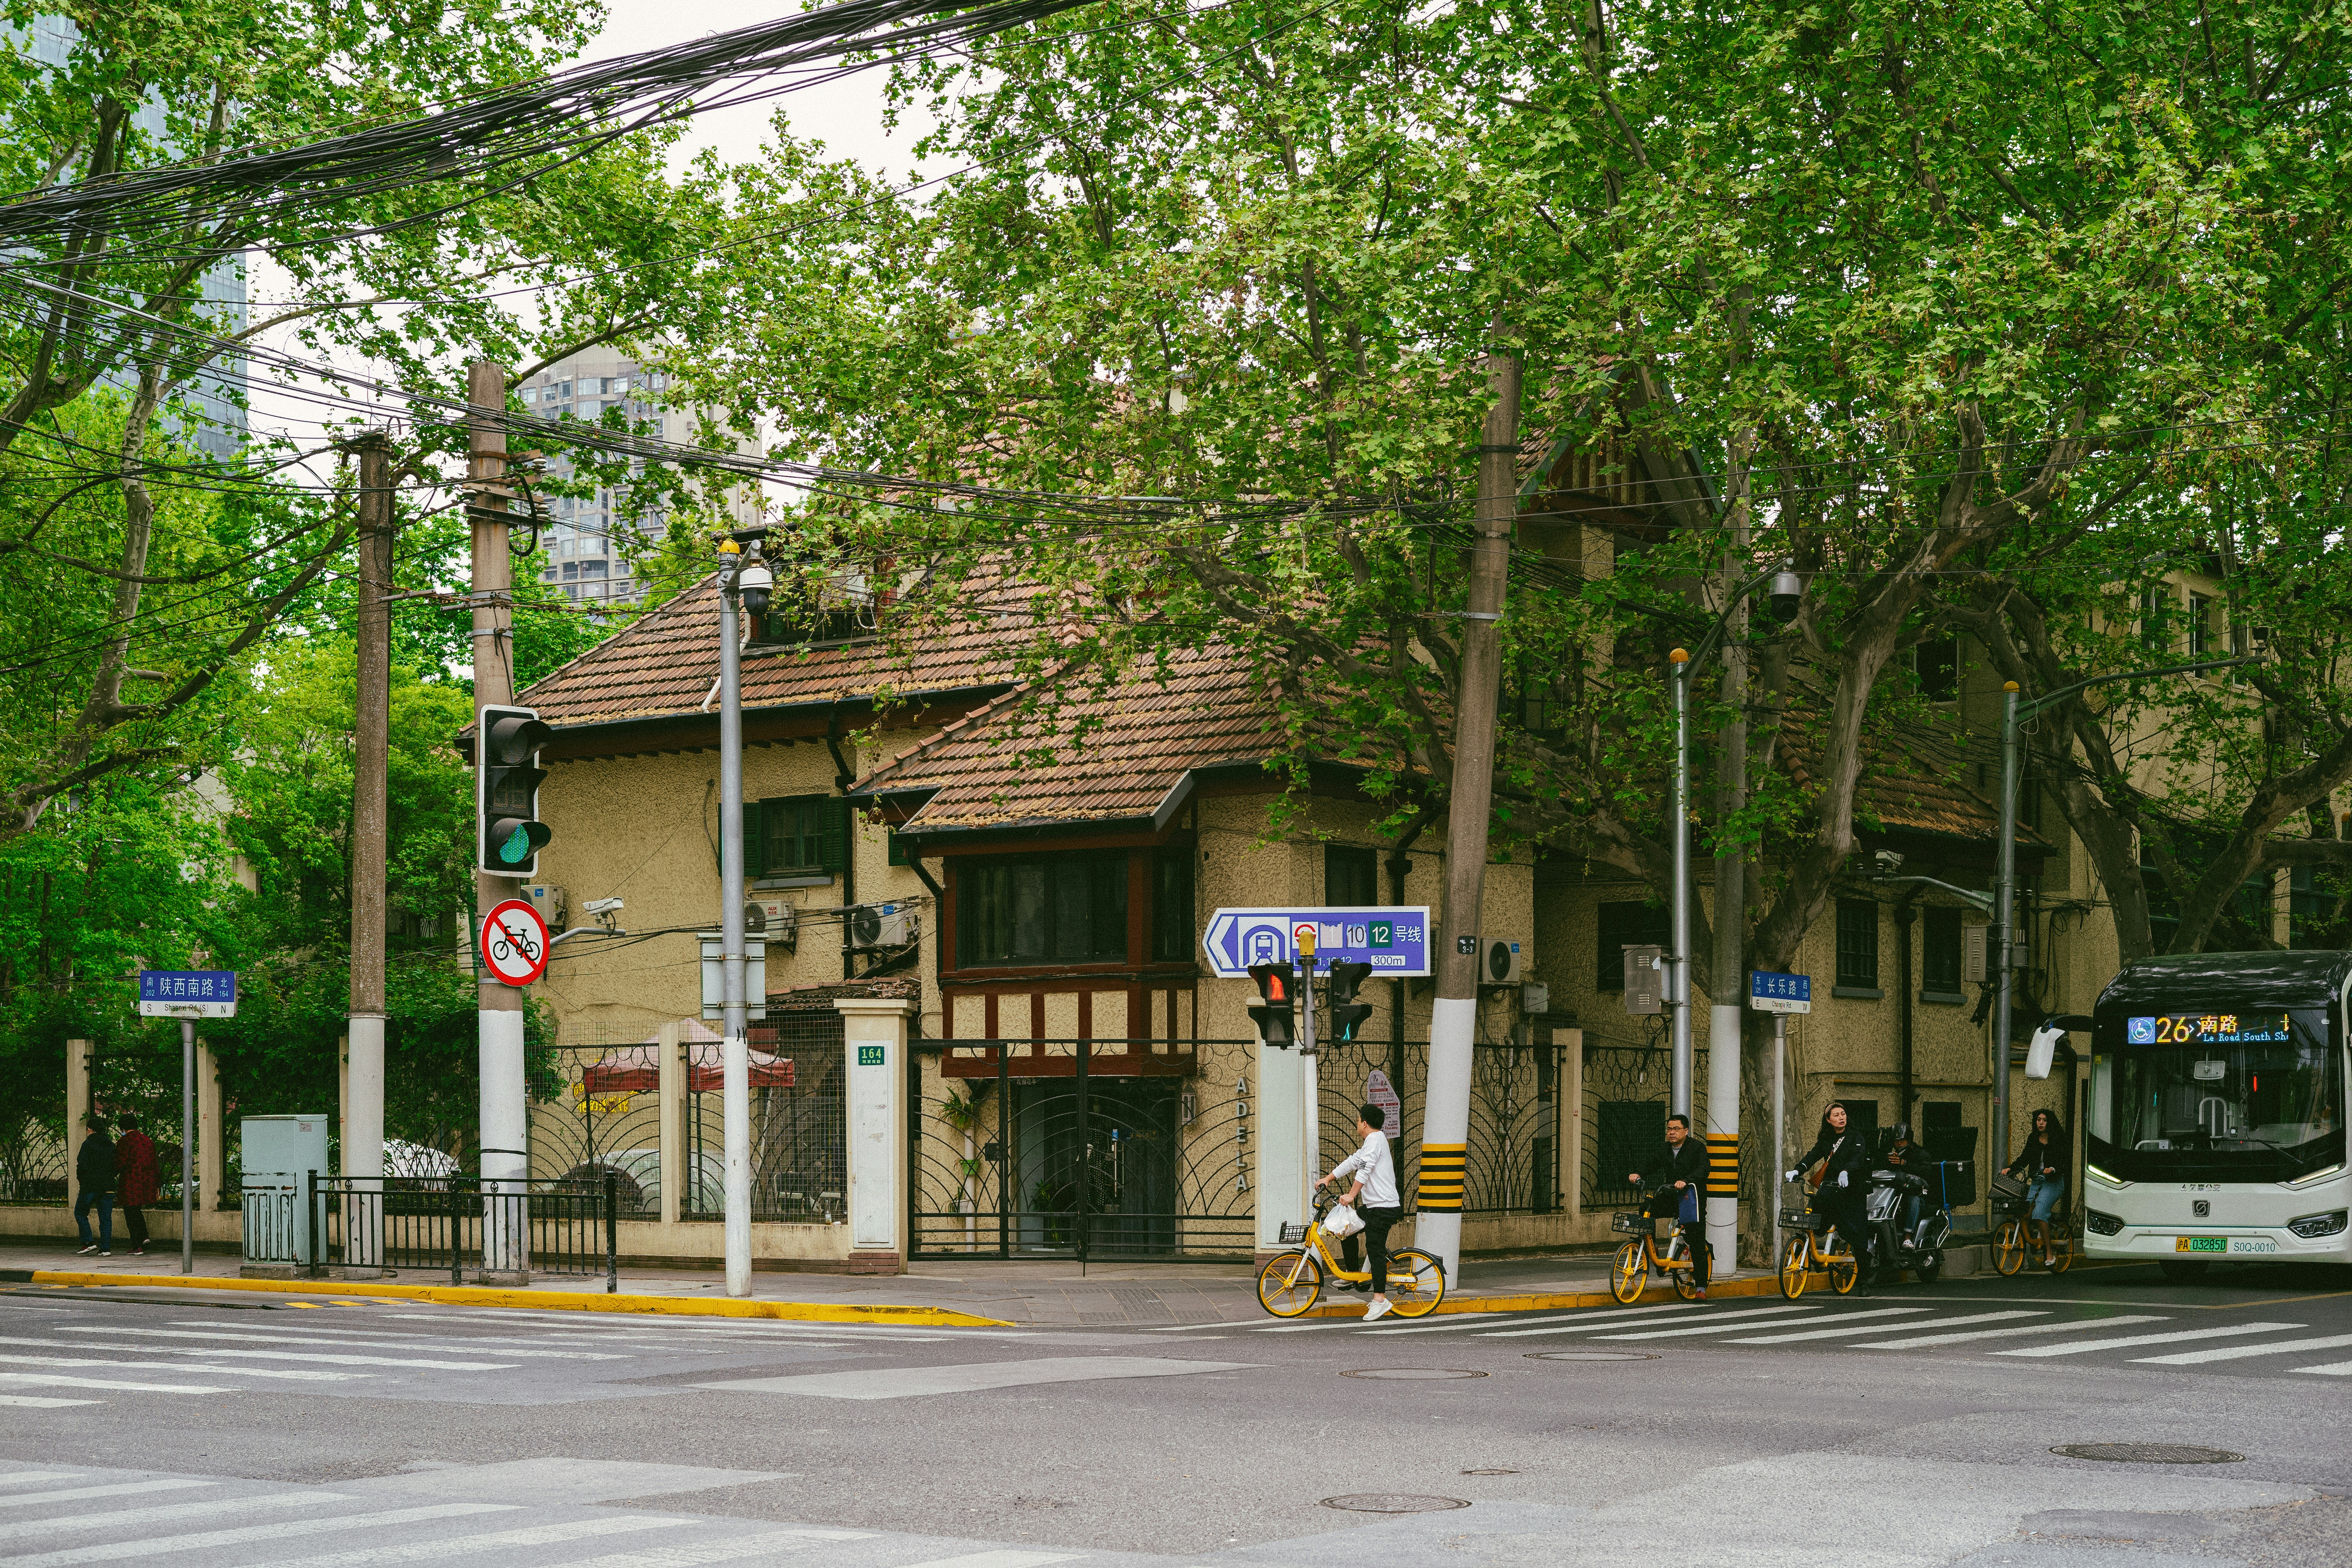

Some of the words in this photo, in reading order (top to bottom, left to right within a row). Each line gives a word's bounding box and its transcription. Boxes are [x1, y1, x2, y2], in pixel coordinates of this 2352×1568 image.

[1328, 926, 1333, 943] 1
[1348, 926, 1365, 943] 10
[1372, 926, 1389, 943] 12
[1394, 926, 1422, 943] 号线
[1374, 956, 1402, 965] 300m
[147, 976, 153, 987] 南
[220, 977, 227, 988] 北
[1756, 975, 1760, 985] 东
[1803, 980, 1807, 989] 西
[160, 977, 213, 997] 陕西南路
[1768, 977, 1796, 996] 长乐路
[147, 1004, 152, 1012] S
[221, 1005, 226, 1014] N
[2156, 1017, 2189, 1042] 26
[2200, 1015, 2237, 1033] 南路
[2204, 1033, 2214, 1041] Le
[2219, 1032, 2240, 1041] Road
[2244, 1031, 2271, 1041] South
[862, 1048, 881, 1058] 164
[1235, 1077, 1247, 1191] ADELA
